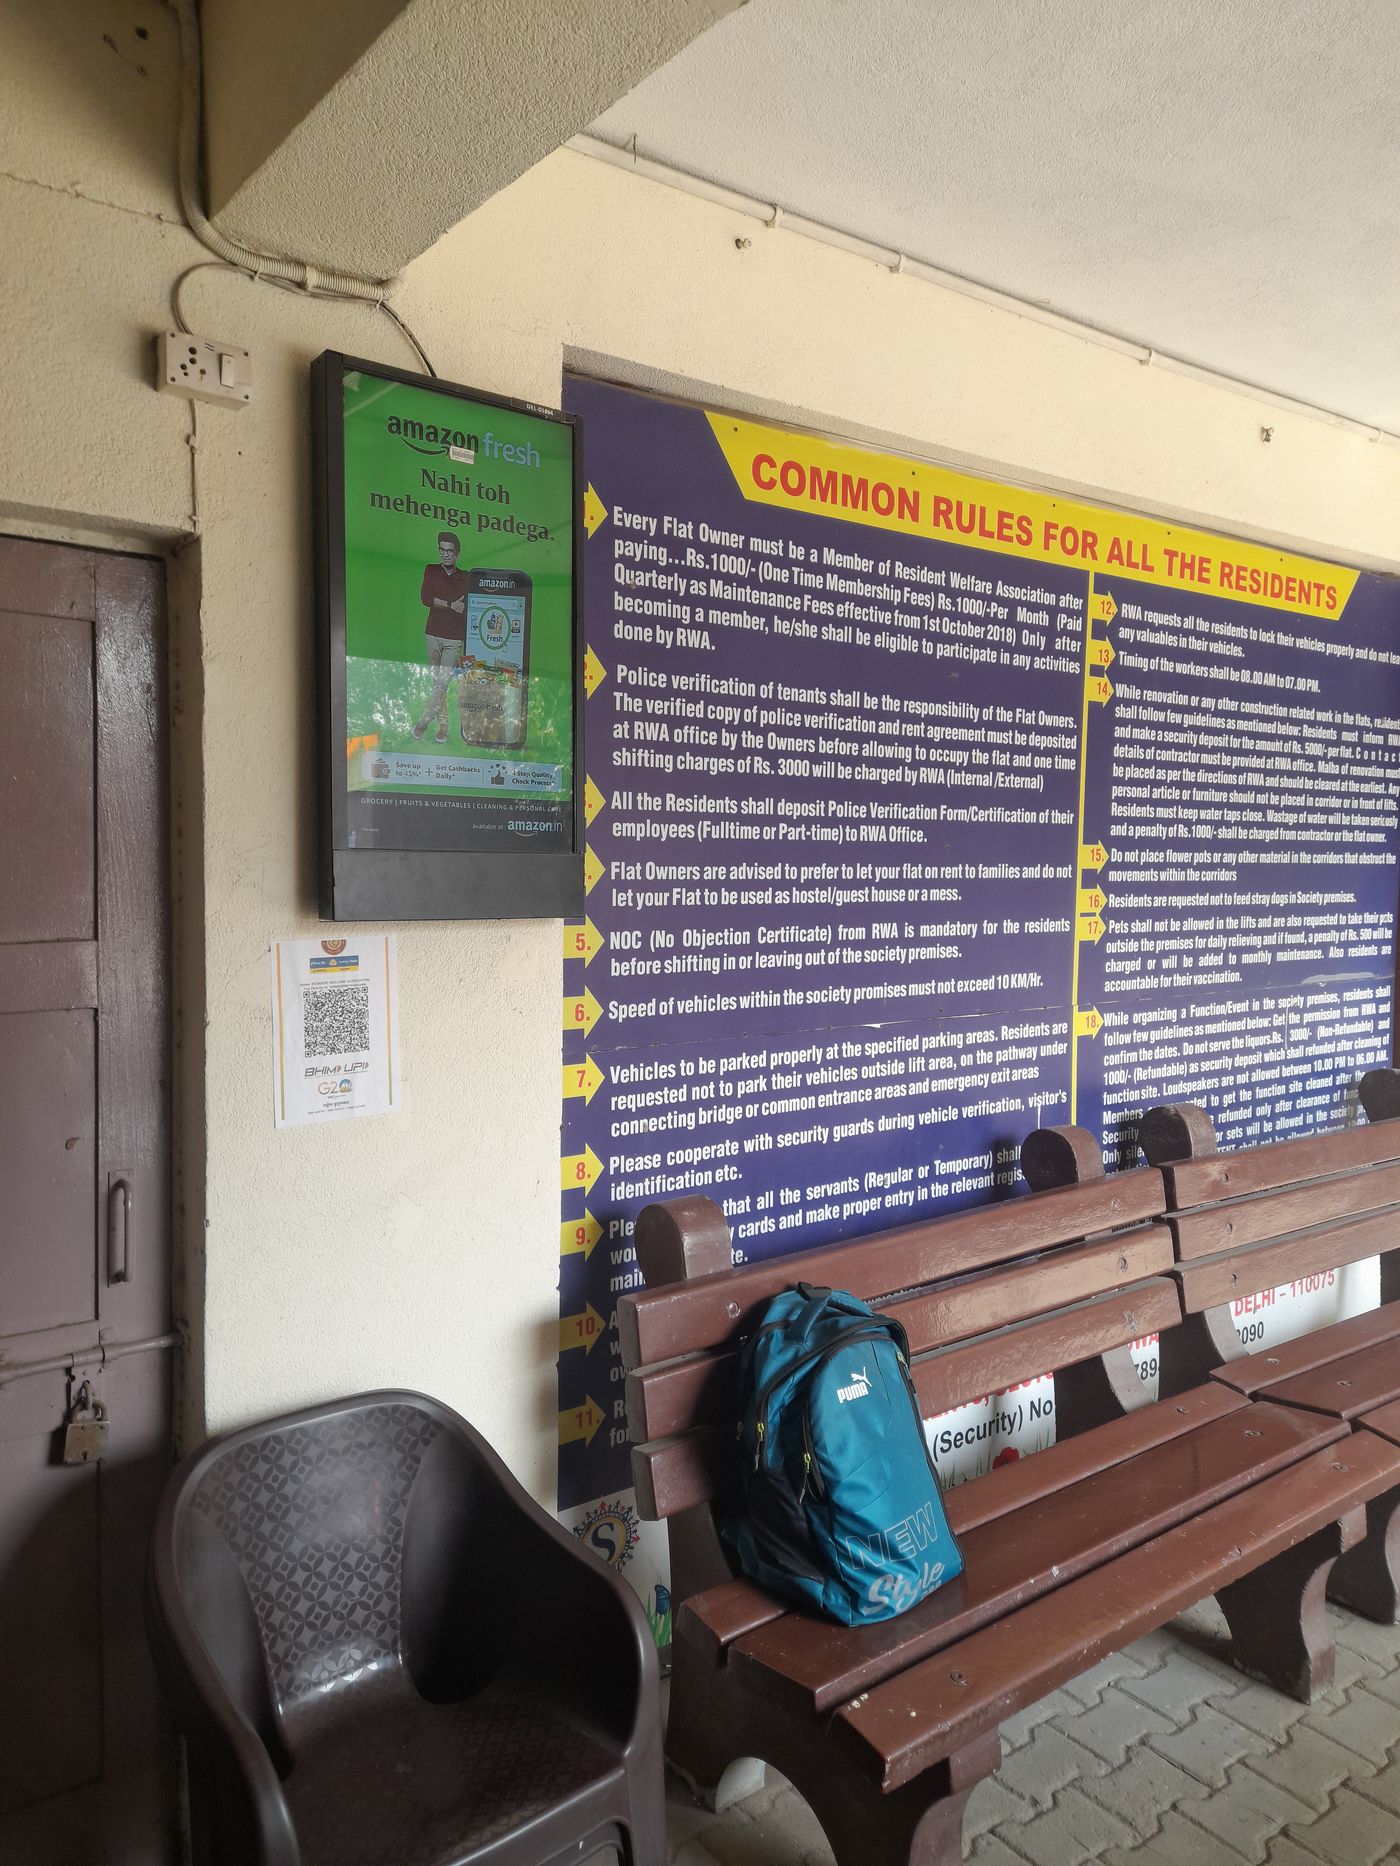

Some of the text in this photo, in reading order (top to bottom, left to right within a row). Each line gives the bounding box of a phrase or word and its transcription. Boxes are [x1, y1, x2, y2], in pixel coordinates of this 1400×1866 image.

[387, 415, 479, 453] amazon
[482, 432, 541, 468] fresh
[420, 468, 511, 505] Nahi toh
[370, 492, 554, 543] mehenga padega.
[752, 453, 1337, 611] COMMON RULES FOR ALL THE RESIDENTS
[612, 504, 1084, 610] Every Flat Owner must be a Member of Resident Welfare Association after
[479, 578, 516, 589] amazon.in
[1100, 601, 1115, 616] 12.
[486, 634, 503, 642] Fresh
[1117, 626, 1245, 657] any valuables in their vehicles.
[1117, 649, 1321, 693] Timing of the workers shall be 08.00 AM to 07.00 PM.
[1097, 682, 1111, 697] 14.
[396, 761, 410, 769] Save
[436, 764, 481, 775] Get Cashbacks
[512, 777, 530, 786] Check
[531, 771, 553, 780] Quality
[361, 797, 393, 806] GROCERY
[400, 799, 423, 807] FRUITS
[431, 801, 471, 809] VEGETABLES
[476, 803, 508, 811] CLEANING
[507, 819, 564, 832] amazon.in
[612, 818, 927, 845] employees (Fulltime or Part-time) to RWA Office.
[1090, 848, 1104, 862] 15.
[1107, 867, 1237, 882] movements within the corridors
[1089, 895, 1103, 908] 16.
[1107, 890, 1356, 909] Residents are requested not to feed stray dogs in Society premises.
[609, 917, 1070, 952] NOC (No Objection Certificate) from RWA is mandatory for the residents
[1088, 921, 1102, 935] 17.
[575, 932, 591, 952] 5.
[1103, 969, 1242, 992] accountable for their vaccination.
[607, 971, 1043, 1022] Speed of vehicles within the society promises must not exceed 10 KM/Hr.
[574, 1003, 591, 1023] 6.
[1086, 1015, 1099, 1028] 18.
[577, 1069, 592, 1089] 7.
[575, 1161, 592, 1181] 8.
[610, 1163, 742, 1201] identification etc.
[722, 1150, 993, 1216] that all the servants (Regular or Temporary)
[575, 1227, 592, 1247] 9.
[1234, 1288, 1275, 1316] DELHI
[1290, 1270, 1335, 1298] 110075
[576, 1317, 600, 1337] 10.
[836, 1381, 869, 1404] PUMA
[576, 1408, 600, 1429] 11.
[933, 1404, 1023, 1462] (Security)
[845, 1501, 938, 1570] NEW
[860, 1562, 945, 1615] Style
